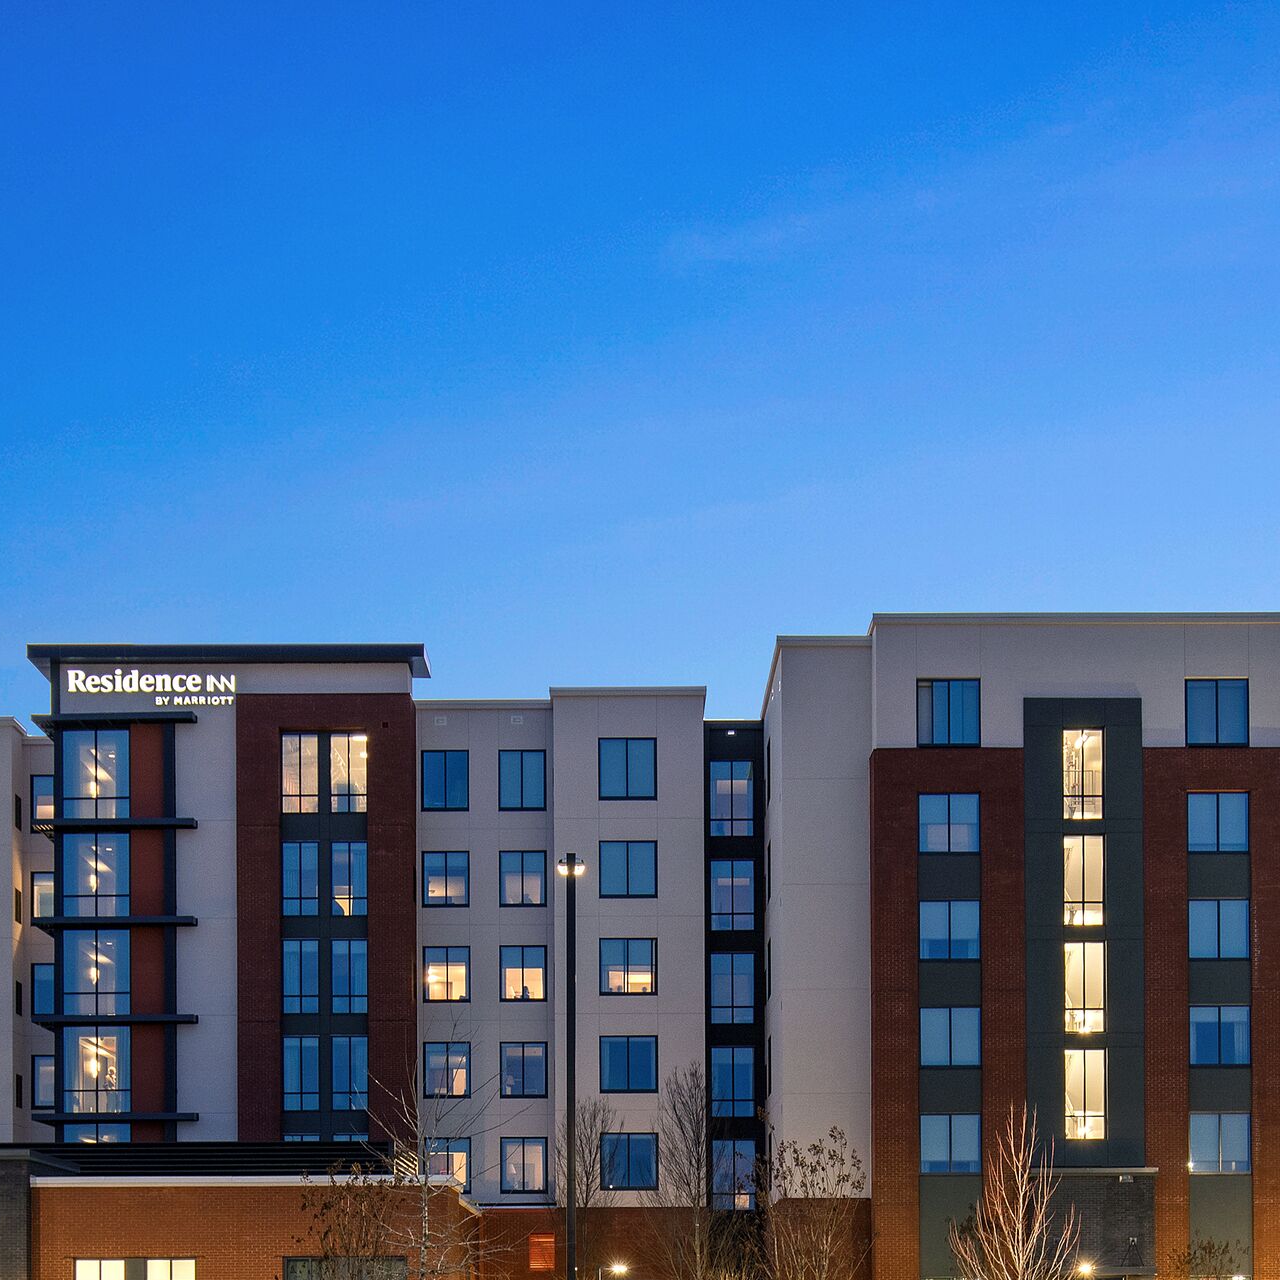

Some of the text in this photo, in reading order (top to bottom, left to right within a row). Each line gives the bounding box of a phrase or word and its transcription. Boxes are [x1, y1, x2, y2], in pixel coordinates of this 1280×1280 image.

[67, 668, 236, 693] Residence INN
[155, 696, 234, 706] BY MARRIOTT
